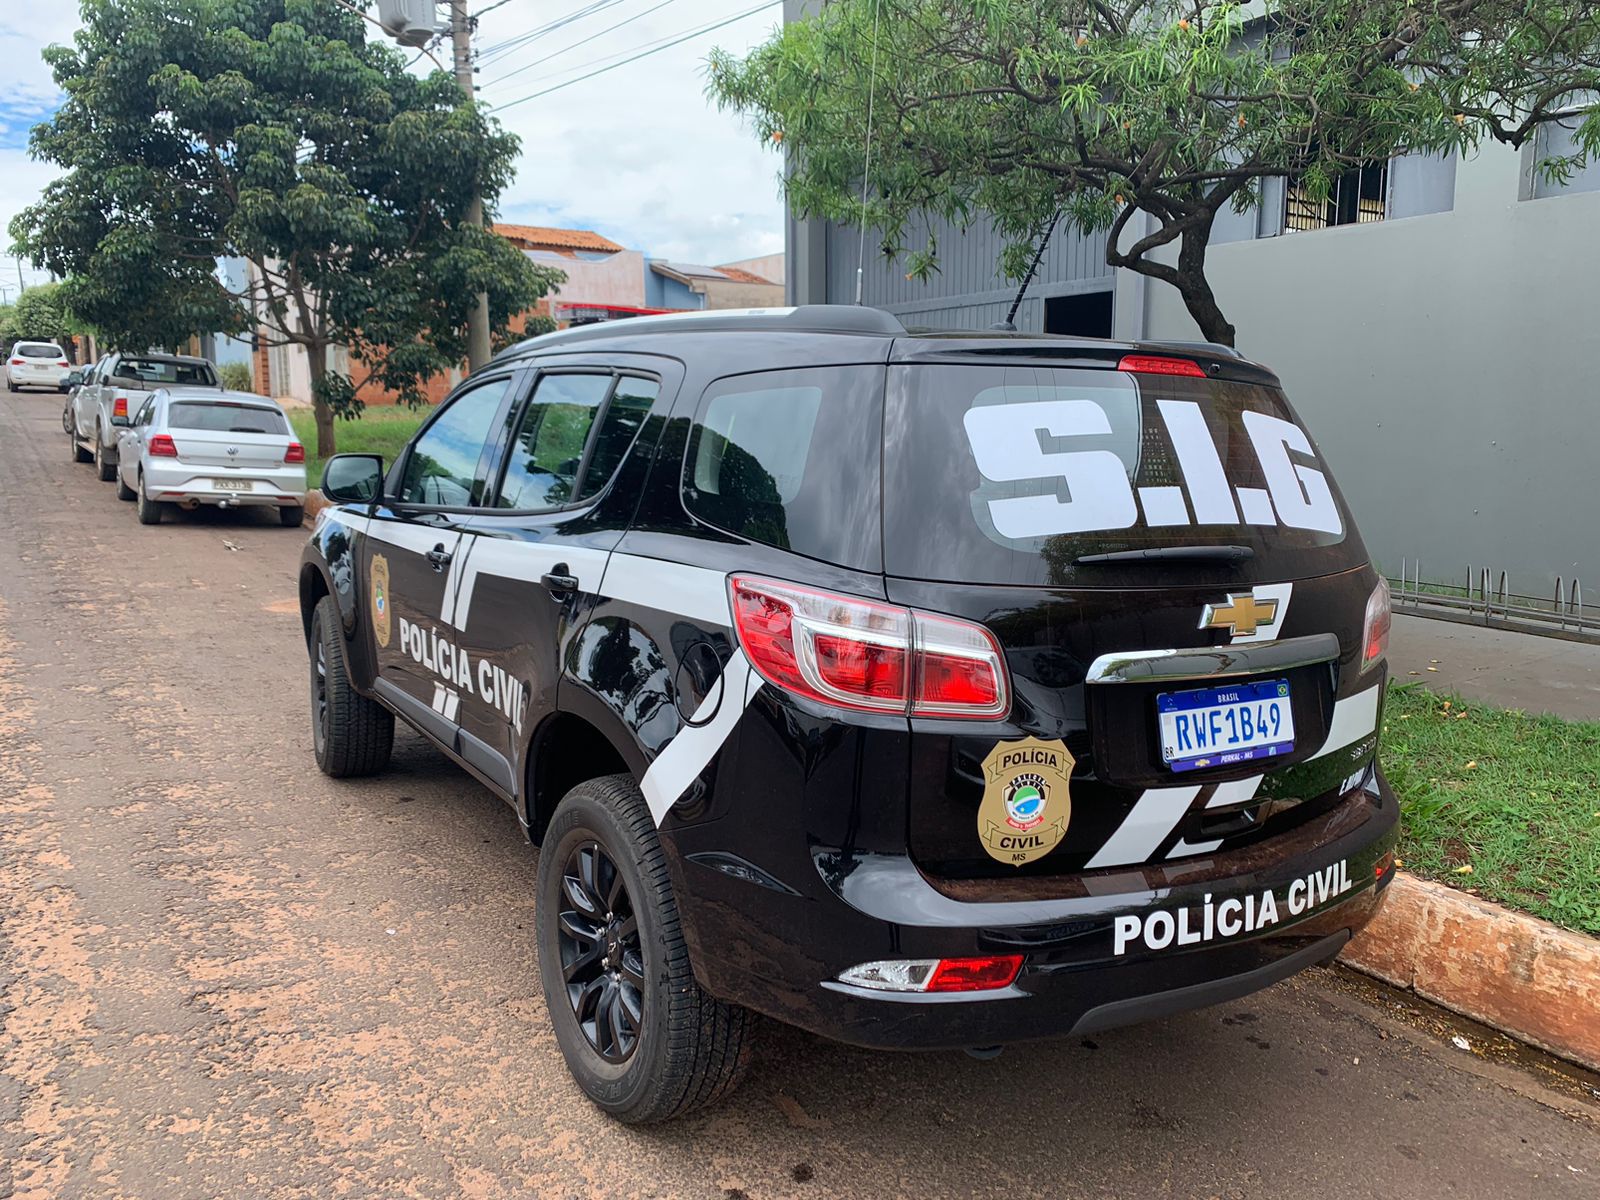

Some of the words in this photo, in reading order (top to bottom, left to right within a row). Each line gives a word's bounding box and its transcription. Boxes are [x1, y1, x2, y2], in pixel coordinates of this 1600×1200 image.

[400, 617, 474, 694] POLÍCIA
[478, 659, 524, 736] CIVIL
[1217, 693, 1240, 703] BRASIL
[1175, 703, 1281, 751] RWF1B49
[1003, 748, 1057, 768] POLÍCIA
[1165, 747, 1174, 758] BR
[1000, 836, 1044, 849] CIVIL
[1012, 853, 1026, 861] MS
[1114, 893, 1279, 955] POLÍCIA
[1288, 859, 1353, 916] CIVIL
